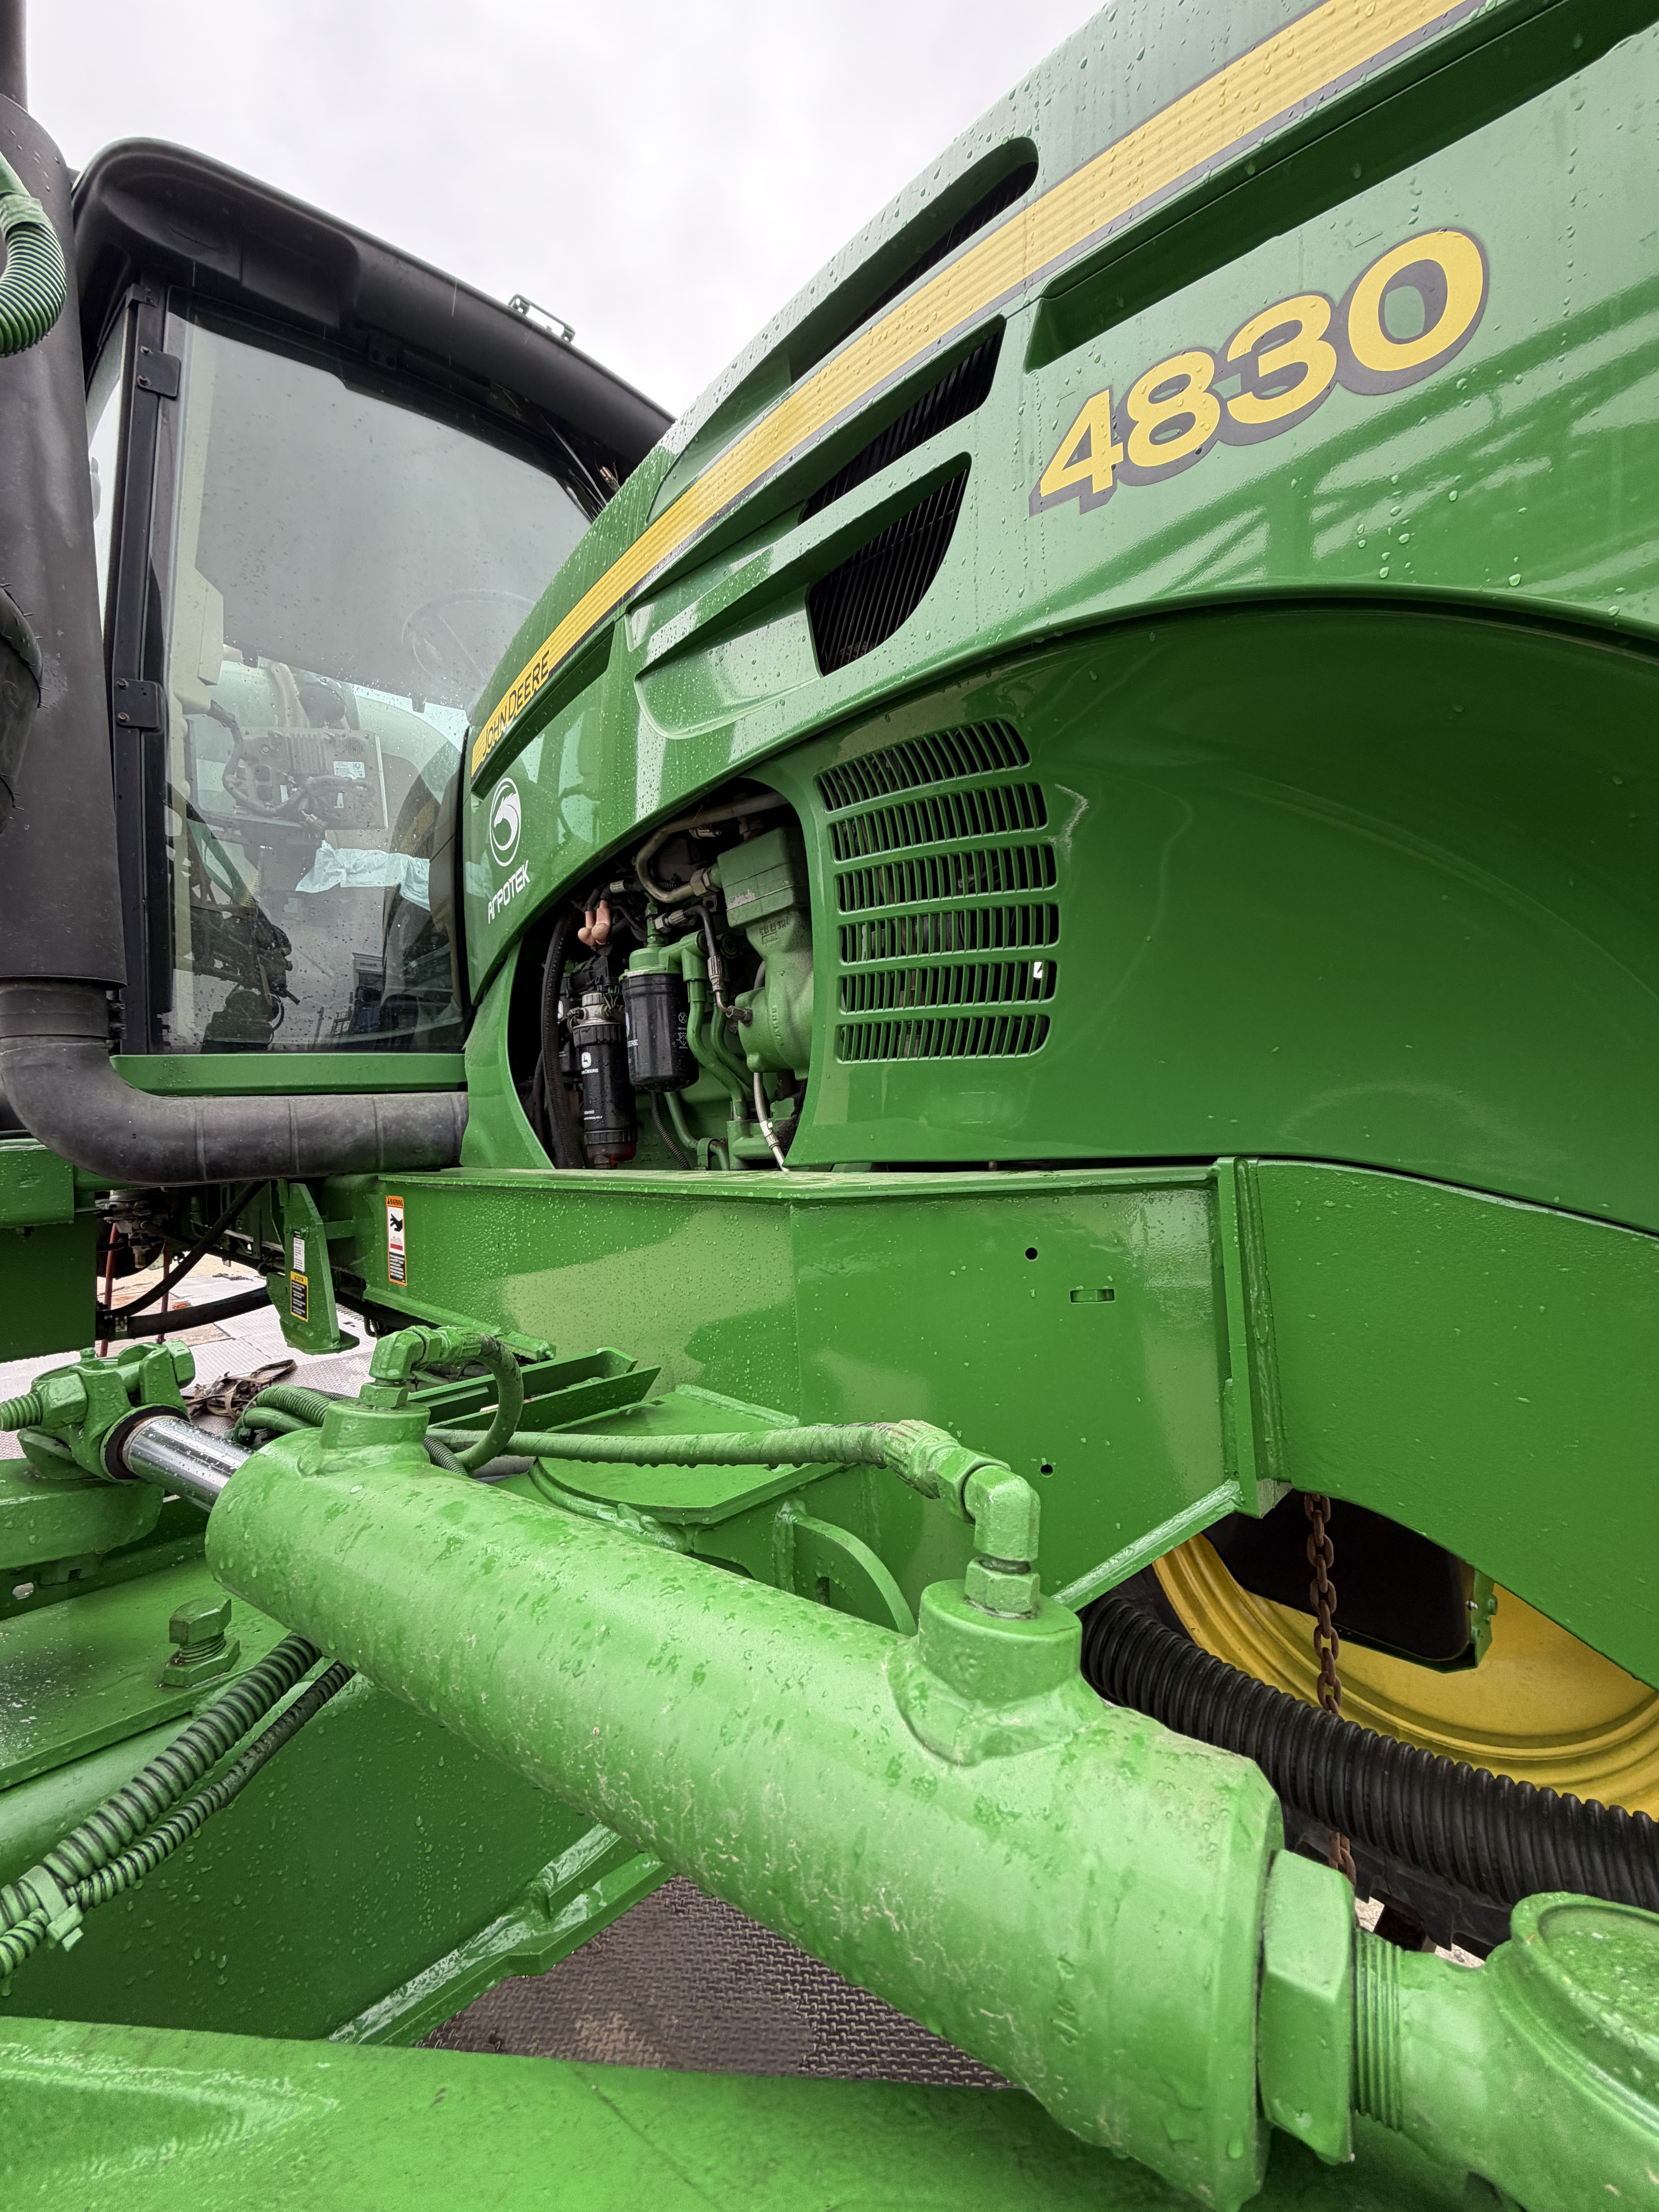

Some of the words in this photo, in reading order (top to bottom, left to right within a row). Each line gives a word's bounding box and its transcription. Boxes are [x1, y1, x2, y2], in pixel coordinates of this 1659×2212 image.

[1038, 228, 1485, 498] 4830
[483, 705, 507, 757] JOHN
[508, 649, 550, 722] DEERE
